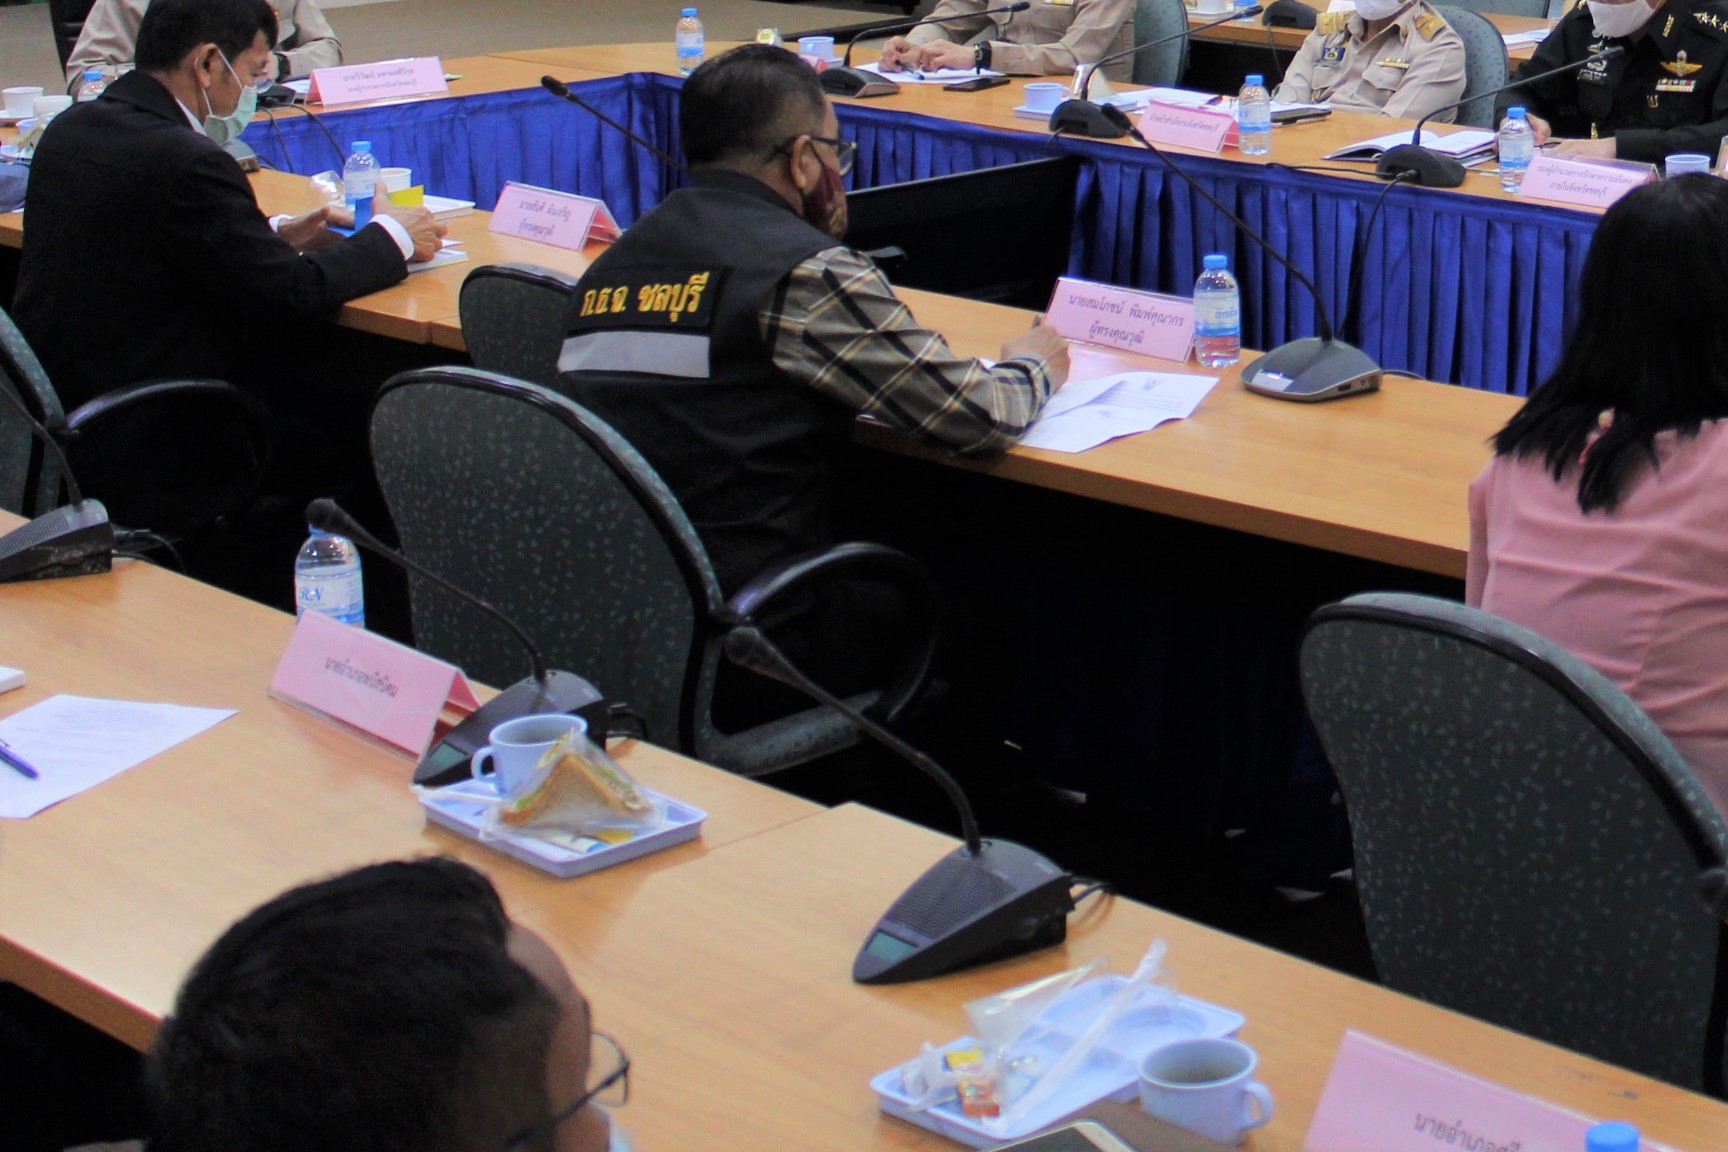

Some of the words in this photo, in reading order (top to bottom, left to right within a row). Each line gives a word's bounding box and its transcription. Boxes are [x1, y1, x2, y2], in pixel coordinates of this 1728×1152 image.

[637, 271, 710, 323] ชลบุรี
[1089, 320, 1146, 347] ผู้ทรงคุณวุฒิ
